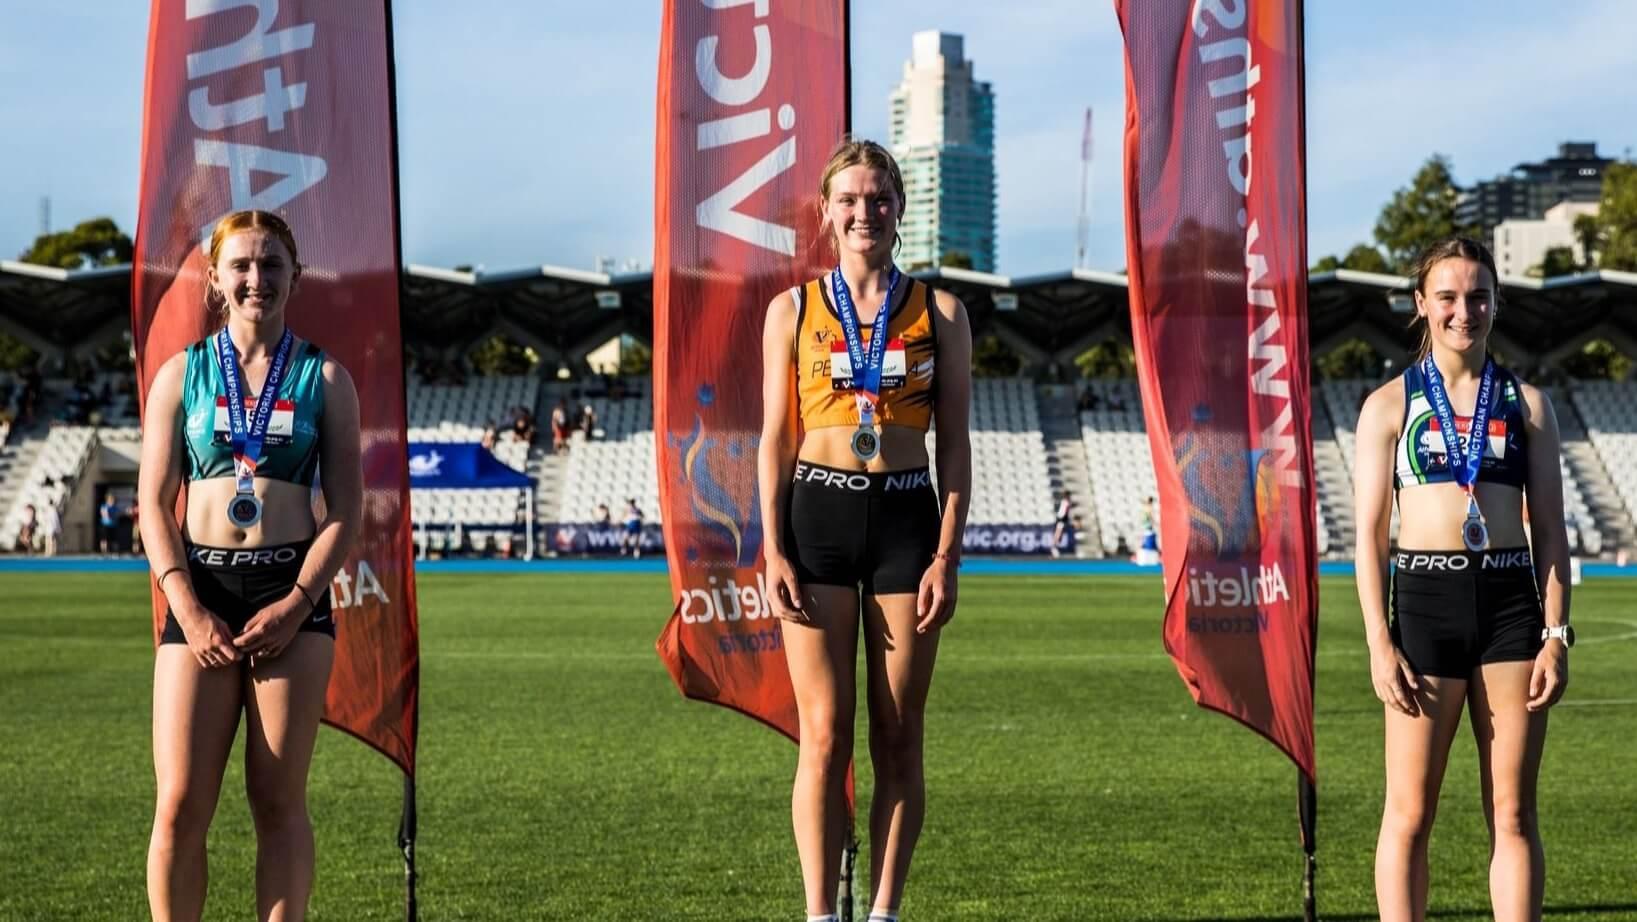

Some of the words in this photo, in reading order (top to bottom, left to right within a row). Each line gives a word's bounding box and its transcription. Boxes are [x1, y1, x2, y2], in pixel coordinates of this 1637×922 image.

[837, 293, 863, 369] CHAMPIONSHIPS
[870, 315, 886, 370] VICTORIAN
[223, 357, 243, 434] CHAMPIONSHIPS
[252, 385, 276, 436] VICTORIAN
[1431, 385, 1461, 467] CHAMPIONSHIPS
[1470, 407, 1487, 461] VICTORIAN
[806, 468, 871, 491] PRO
[230, 548, 297, 566] PRO
[1410, 555, 1469, 571] PRO
[1481, 552, 1530, 570] NIKE
